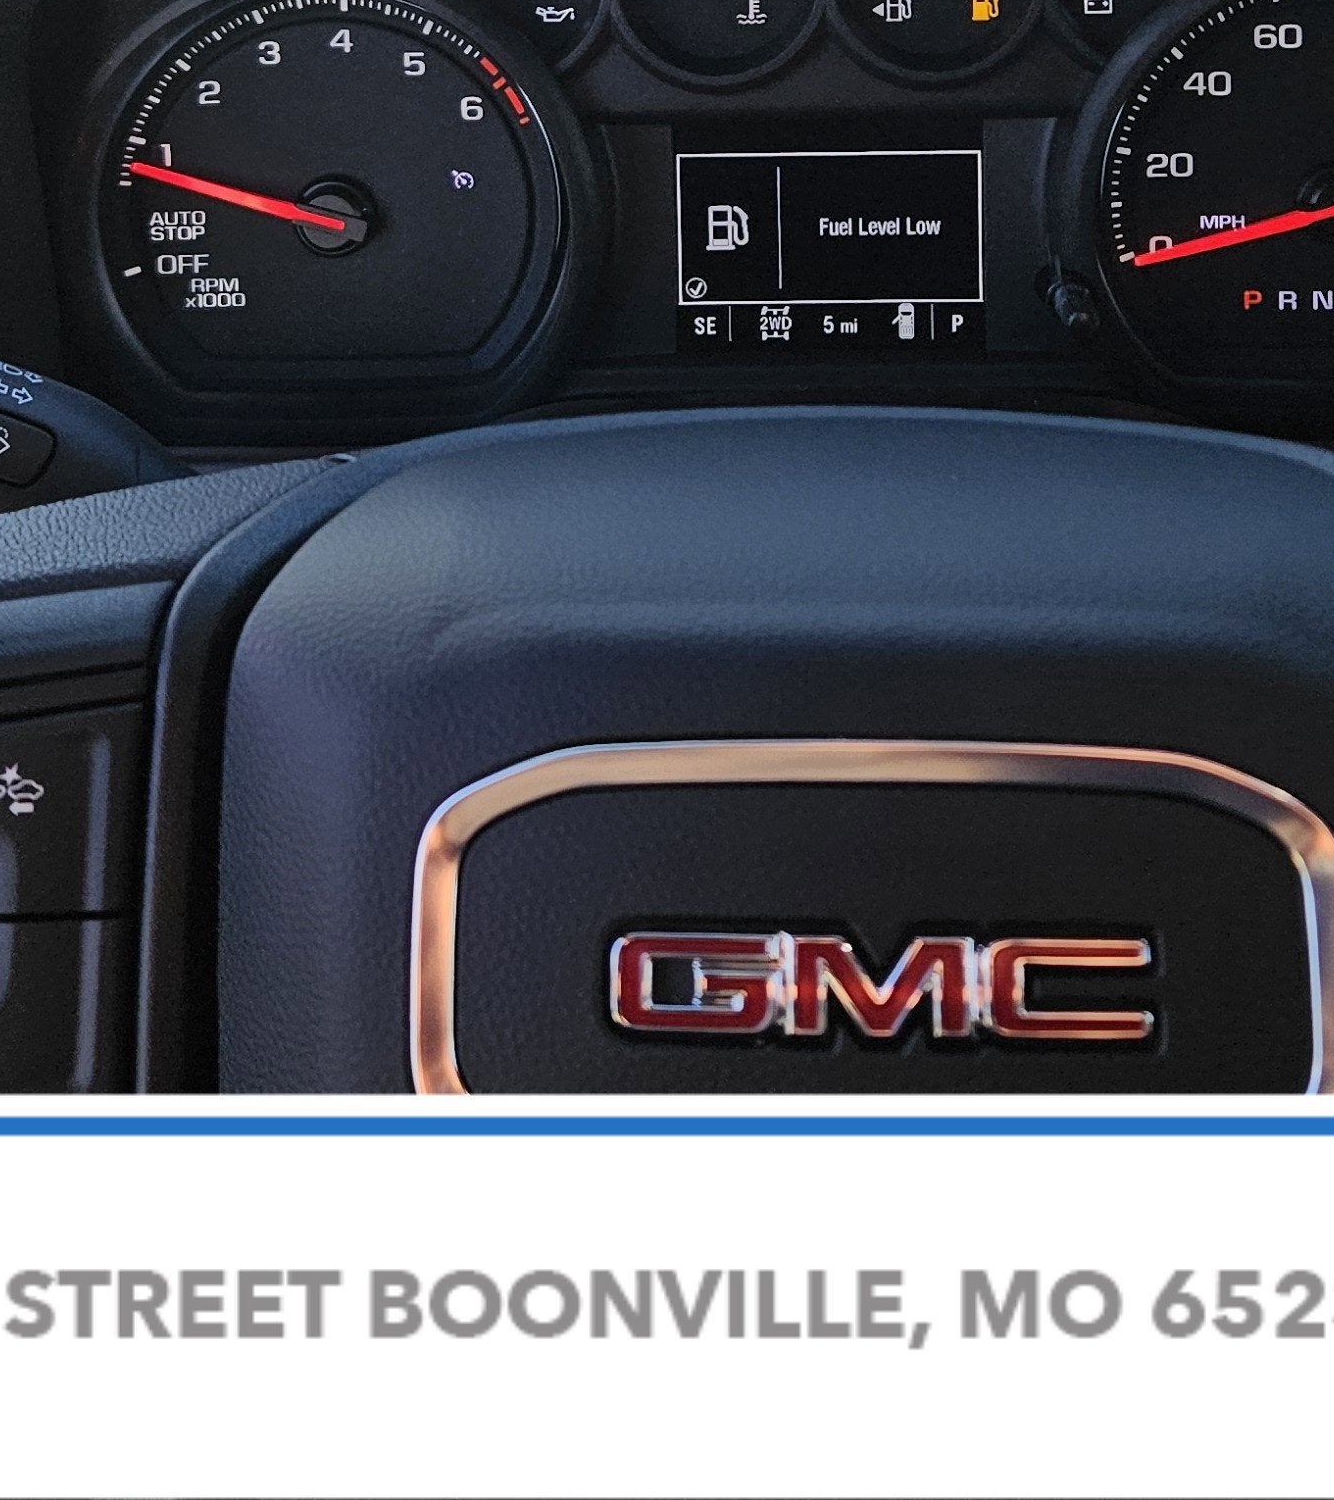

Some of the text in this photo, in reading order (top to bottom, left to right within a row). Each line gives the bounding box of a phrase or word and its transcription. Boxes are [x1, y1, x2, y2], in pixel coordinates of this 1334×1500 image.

[329, 28, 354, 53] 4
[1253, 23, 1303, 49] 60
[258, 40, 282, 65] 3
[403, 51, 426, 76] 5
[198, 80, 221, 105] 2
[1183, 71, 1232, 97] 40
[460, 96, 484, 121] 6
[159, 143, 172, 167] 1
[1146, 152, 1194, 178] 20
[149, 210, 206, 226] AUTO
[819, 215, 942, 237] Fuel Level Low
[1199, 214, 1247, 231] MPH
[150, 226, 206, 242] STOP
[156, 253, 210, 275] OFF
[190, 277, 240, 293] RPM
[184, 293, 246, 309] x1000
[1243, 289, 1263, 311] P
[1278, 290, 1298, 311] R
[1312, 289, 1334, 311] N
[693, 316, 717, 336] SE
[759, 314, 793, 331] 2WD
[823, 315, 859, 334] 5 mi
[951, 314, 964, 333] P
[609, 930, 1155, 1040] GMC
